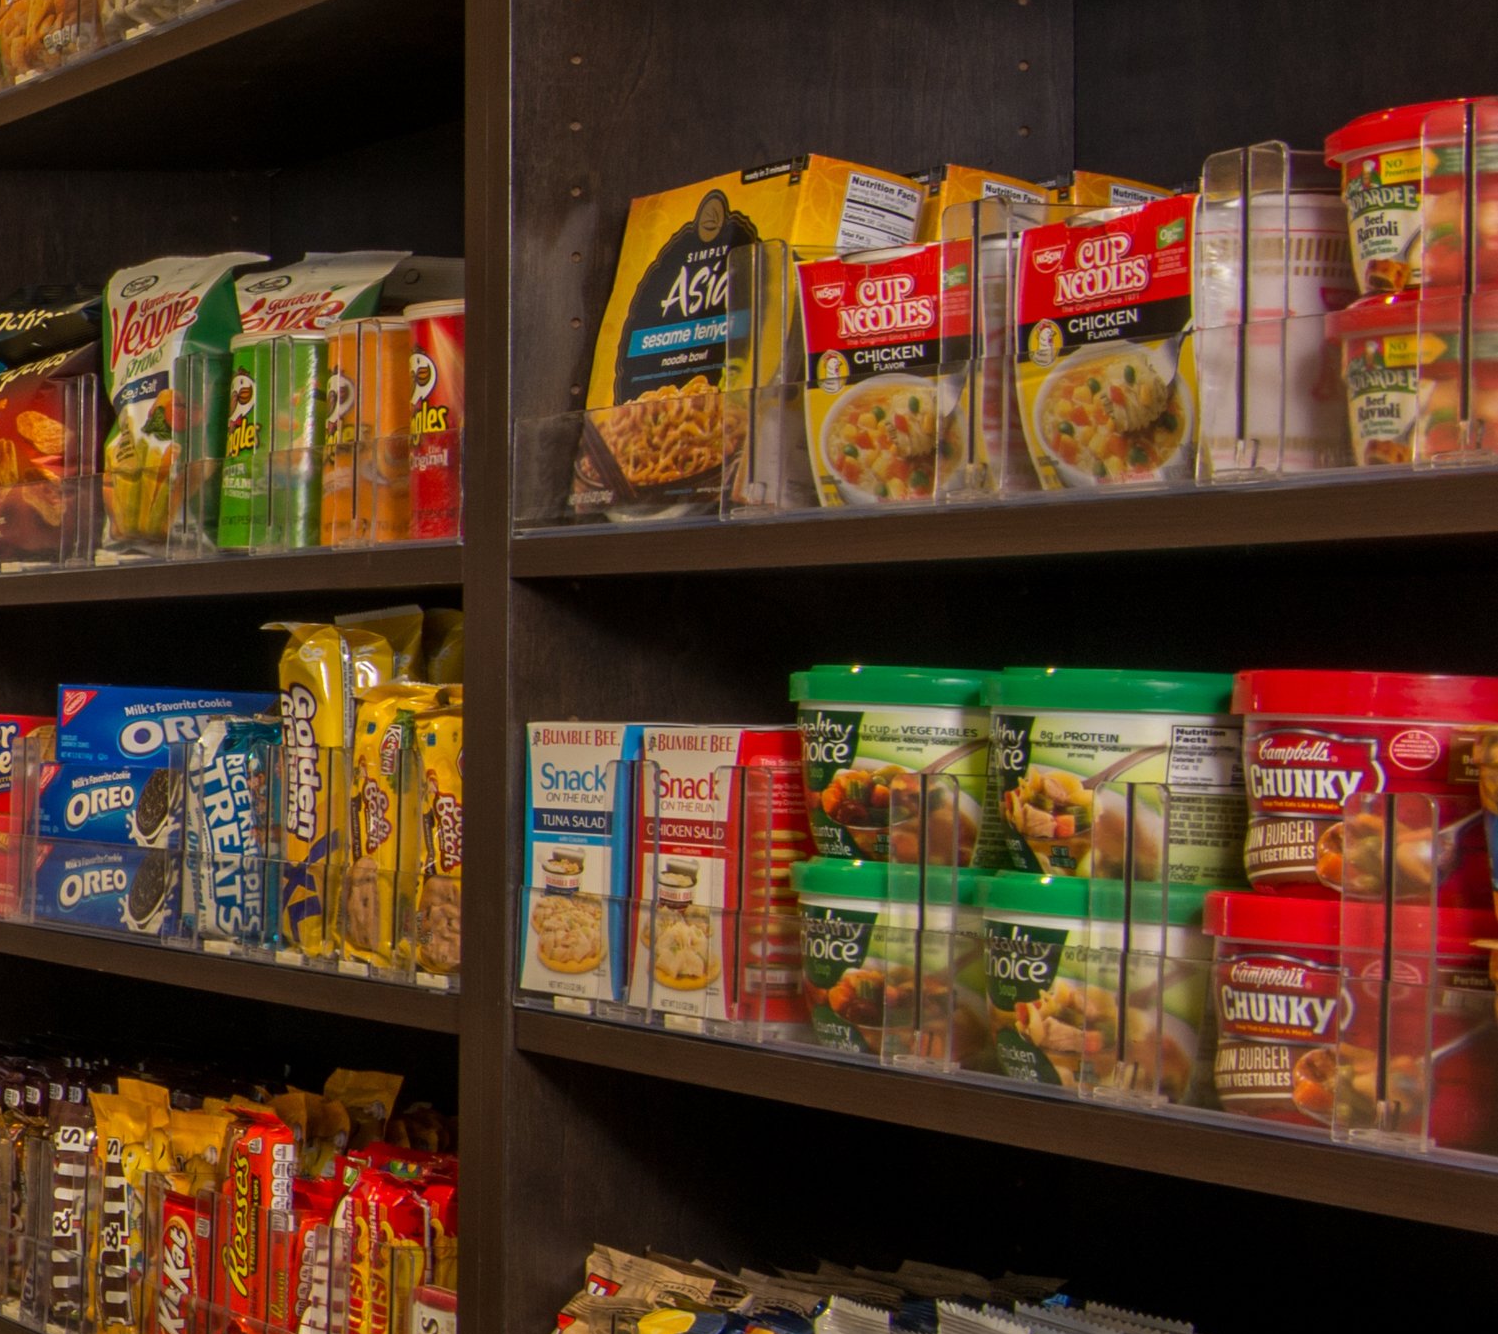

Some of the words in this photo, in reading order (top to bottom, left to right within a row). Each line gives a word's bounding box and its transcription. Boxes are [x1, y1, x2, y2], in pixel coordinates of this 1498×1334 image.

[1385, 157, 1404, 170] NO
[851, 175, 895, 196] Nutrition
[896, 189, 919, 205] Facts
[1363, 212, 1385, 228] Beef
[1356, 221, 1400, 245] Ravioli
[687, 243, 729, 263] SIMPLY
[1075, 234, 1132, 269] CUP
[858, 273, 914, 305] CUP
[1053, 257, 1149, 306] NOODLES
[266, 291, 320, 315] garden
[838, 295, 936, 337] NOODLES
[1067, 308, 1139, 335] CHICKEN
[111, 290, 200, 370] Veggie
[641, 327, 690, 351] sesame
[693, 319, 729, 342] teriya
[1086, 327, 1121, 341] FLAVOR
[661, 353, 688, 368] noodle
[689, 349, 709, 365] bowl
[853, 344, 925, 365] CHICKEN
[872, 360, 906, 373] FLAVOR
[1365, 393, 1388, 409] Beef
[124, 702, 156, 717] Milk's
[156, 697, 197, 714] Favorite
[198, 698, 233, 710] Cookie
[542, 728, 592, 747] BUMBLE
[594, 729, 620, 748] BEE
[657, 732, 708, 752] BUMBLE
[709, 734, 735, 753] BEE
[869, 724, 891, 738] cup
[901, 723, 978, 739] VEGETABLES
[1040, 729, 1054, 744] 8g
[1062, 731, 1119, 745] PROTEIN
[1175, 727, 1227, 740] Nutrition
[1175, 735, 1209, 747] Facts
[288, 683, 321, 843] Golden
[1257, 736, 1331, 767] Campbell's
[540, 762, 607, 793] Snack
[654, 769, 721, 802] Snack
[1249, 764, 1363, 802] CHUNKY
[66, 784, 136, 827] OREO
[545, 792, 561, 804] ON
[562, 792, 579, 804] THE
[542, 813, 571, 827] TUNA
[571, 814, 606, 829] SALAD
[646, 823, 692, 841] CHICKEN
[1266, 819, 1316, 847] BURGER
[204, 753, 244, 937] TREATS
[1258, 845, 1316, 864] VEGETABLES
[59, 868, 128, 909] OREO
[1230, 962, 1306, 989] Campbell's
[1220, 985, 1337, 1036] CHUNKY
[1238, 1045, 1291, 1072] BURGER
[1232, 1066, 1292, 1090] VEGETABLES
[221, 1147, 250, 1297] Reese's
